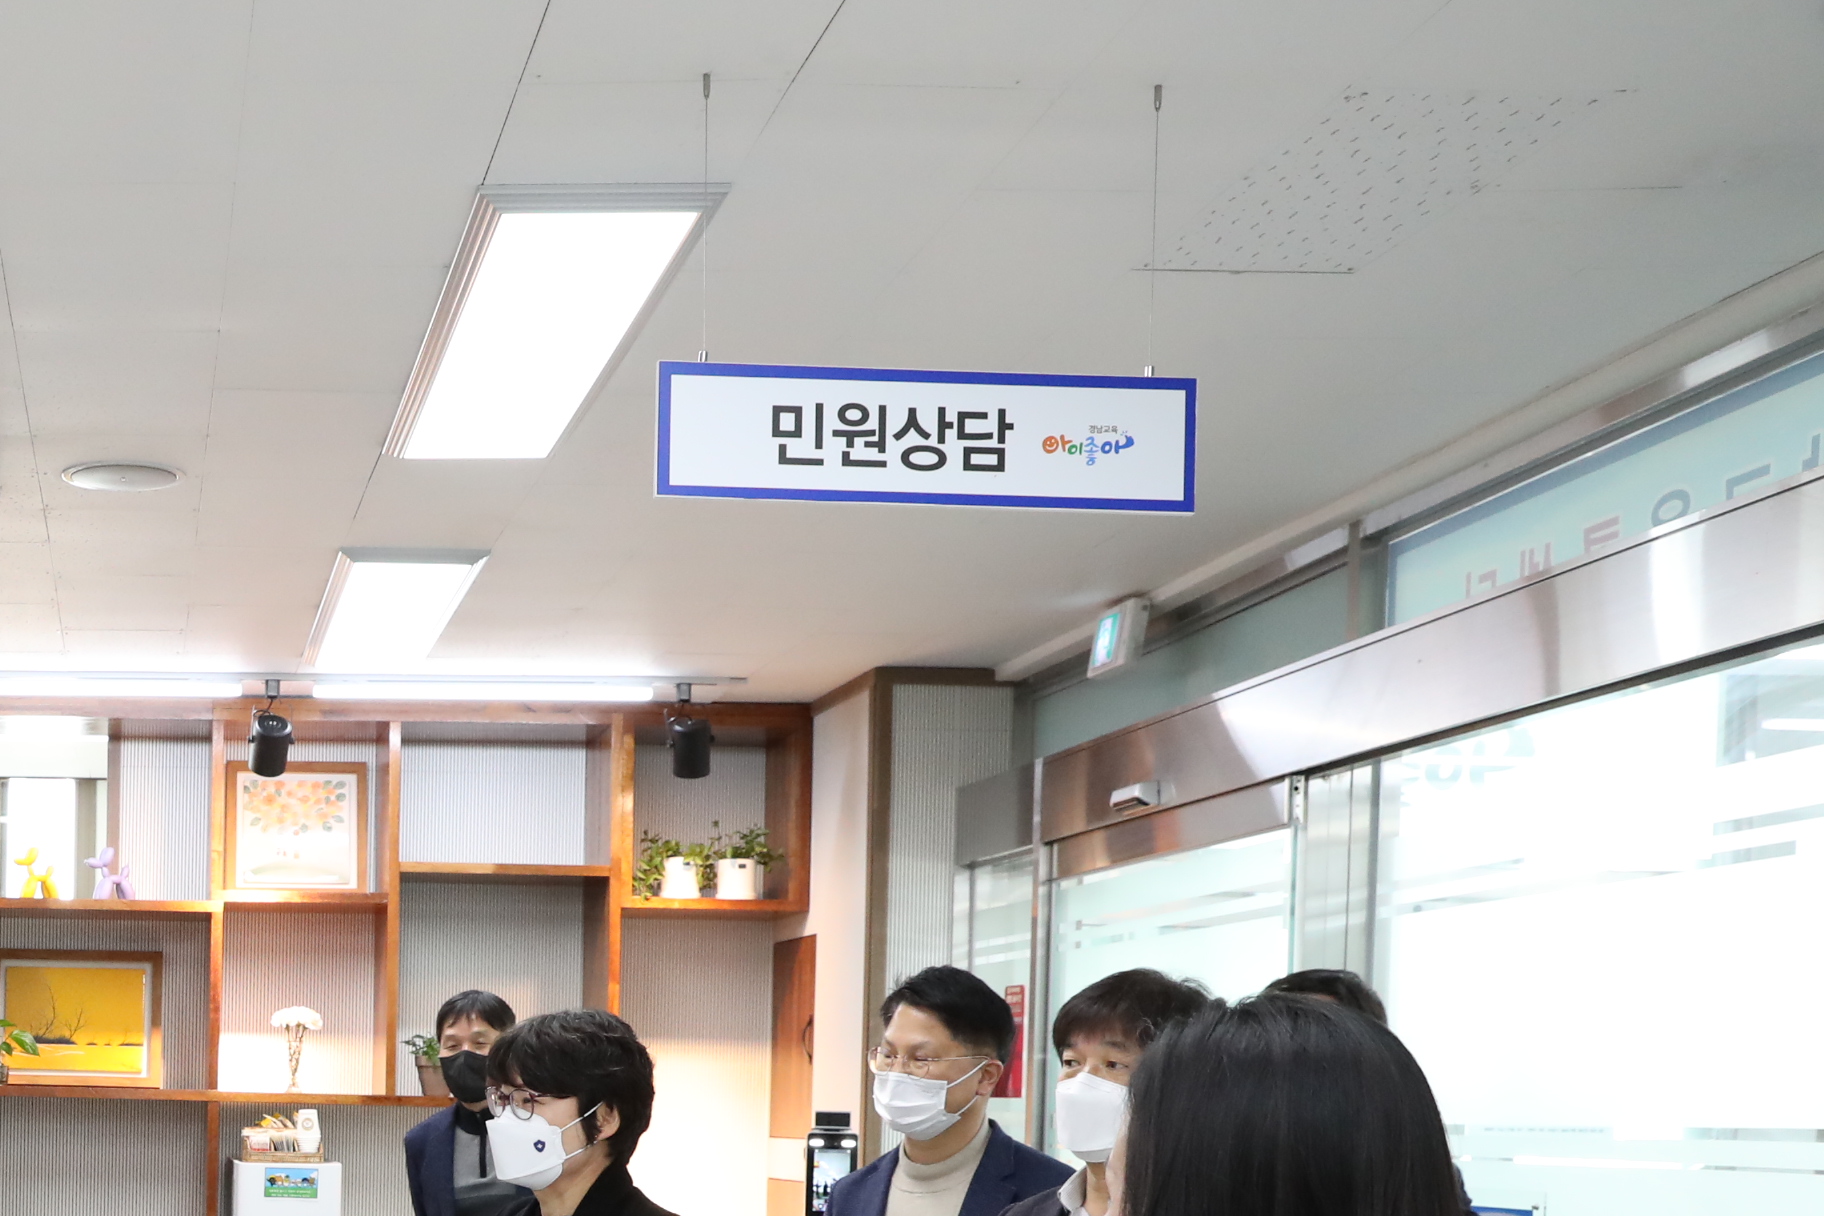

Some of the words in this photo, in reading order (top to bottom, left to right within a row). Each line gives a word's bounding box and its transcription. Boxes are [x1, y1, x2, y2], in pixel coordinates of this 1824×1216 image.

[771, 402, 1015, 473] 민원상담
[1088, 424, 1119, 435] 경남교육
[1042, 432, 1135, 467] 아이좋아
